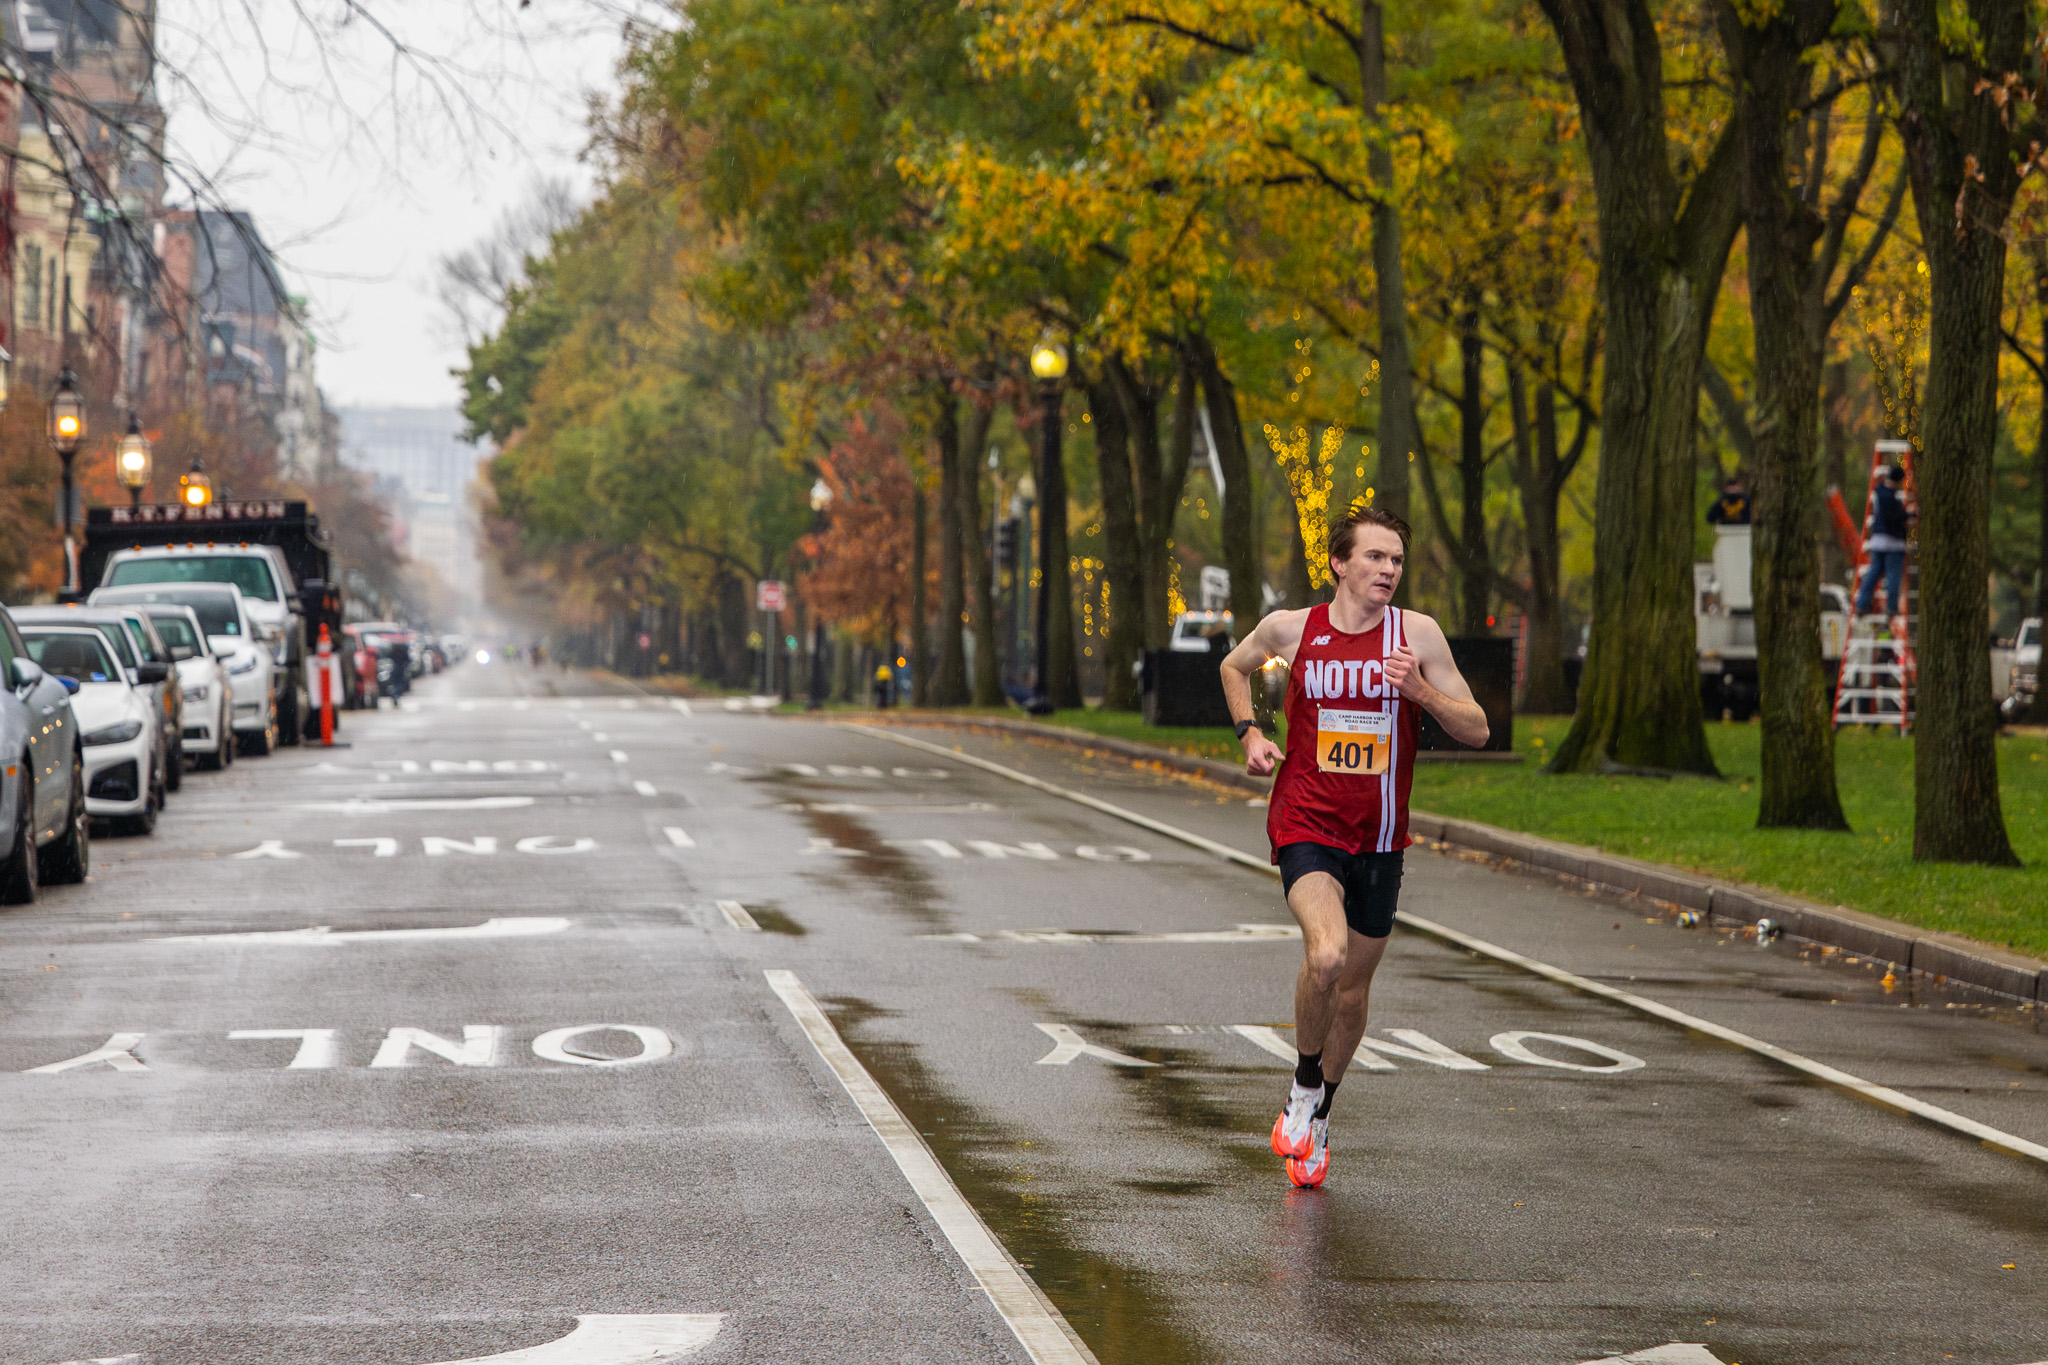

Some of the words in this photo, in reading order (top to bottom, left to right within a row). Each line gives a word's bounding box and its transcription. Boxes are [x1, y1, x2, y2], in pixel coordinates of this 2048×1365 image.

[1328, 741, 1373, 769] 401
[230, 836, 598, 859] ONLY
[22, 1024, 673, 1073] ONLY
